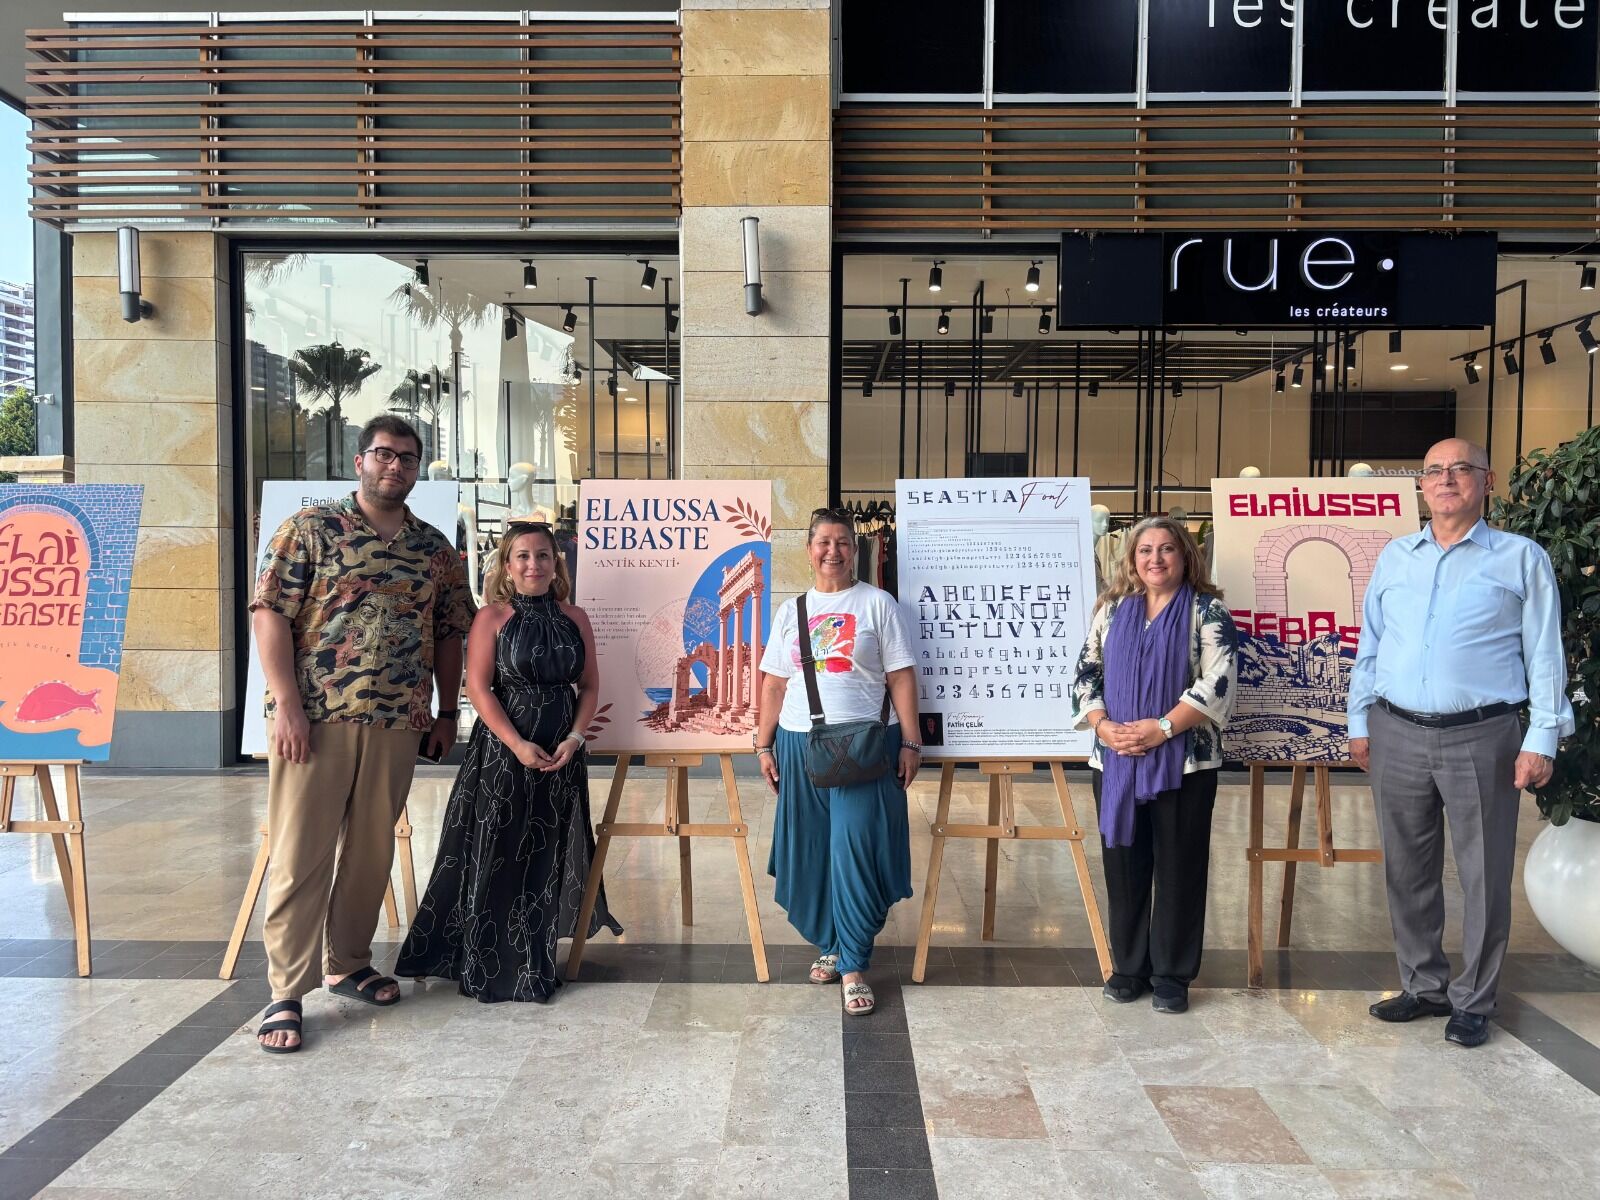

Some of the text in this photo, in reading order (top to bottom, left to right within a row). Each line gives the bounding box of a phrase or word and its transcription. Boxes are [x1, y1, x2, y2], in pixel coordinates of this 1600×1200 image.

[1290, 302, 1388, 317] les créateurs
[1018, 481, 1077, 513] Font
[586, 498, 722, 521] ELAIUSSA
[585, 526, 709, 550] SEBASTE
